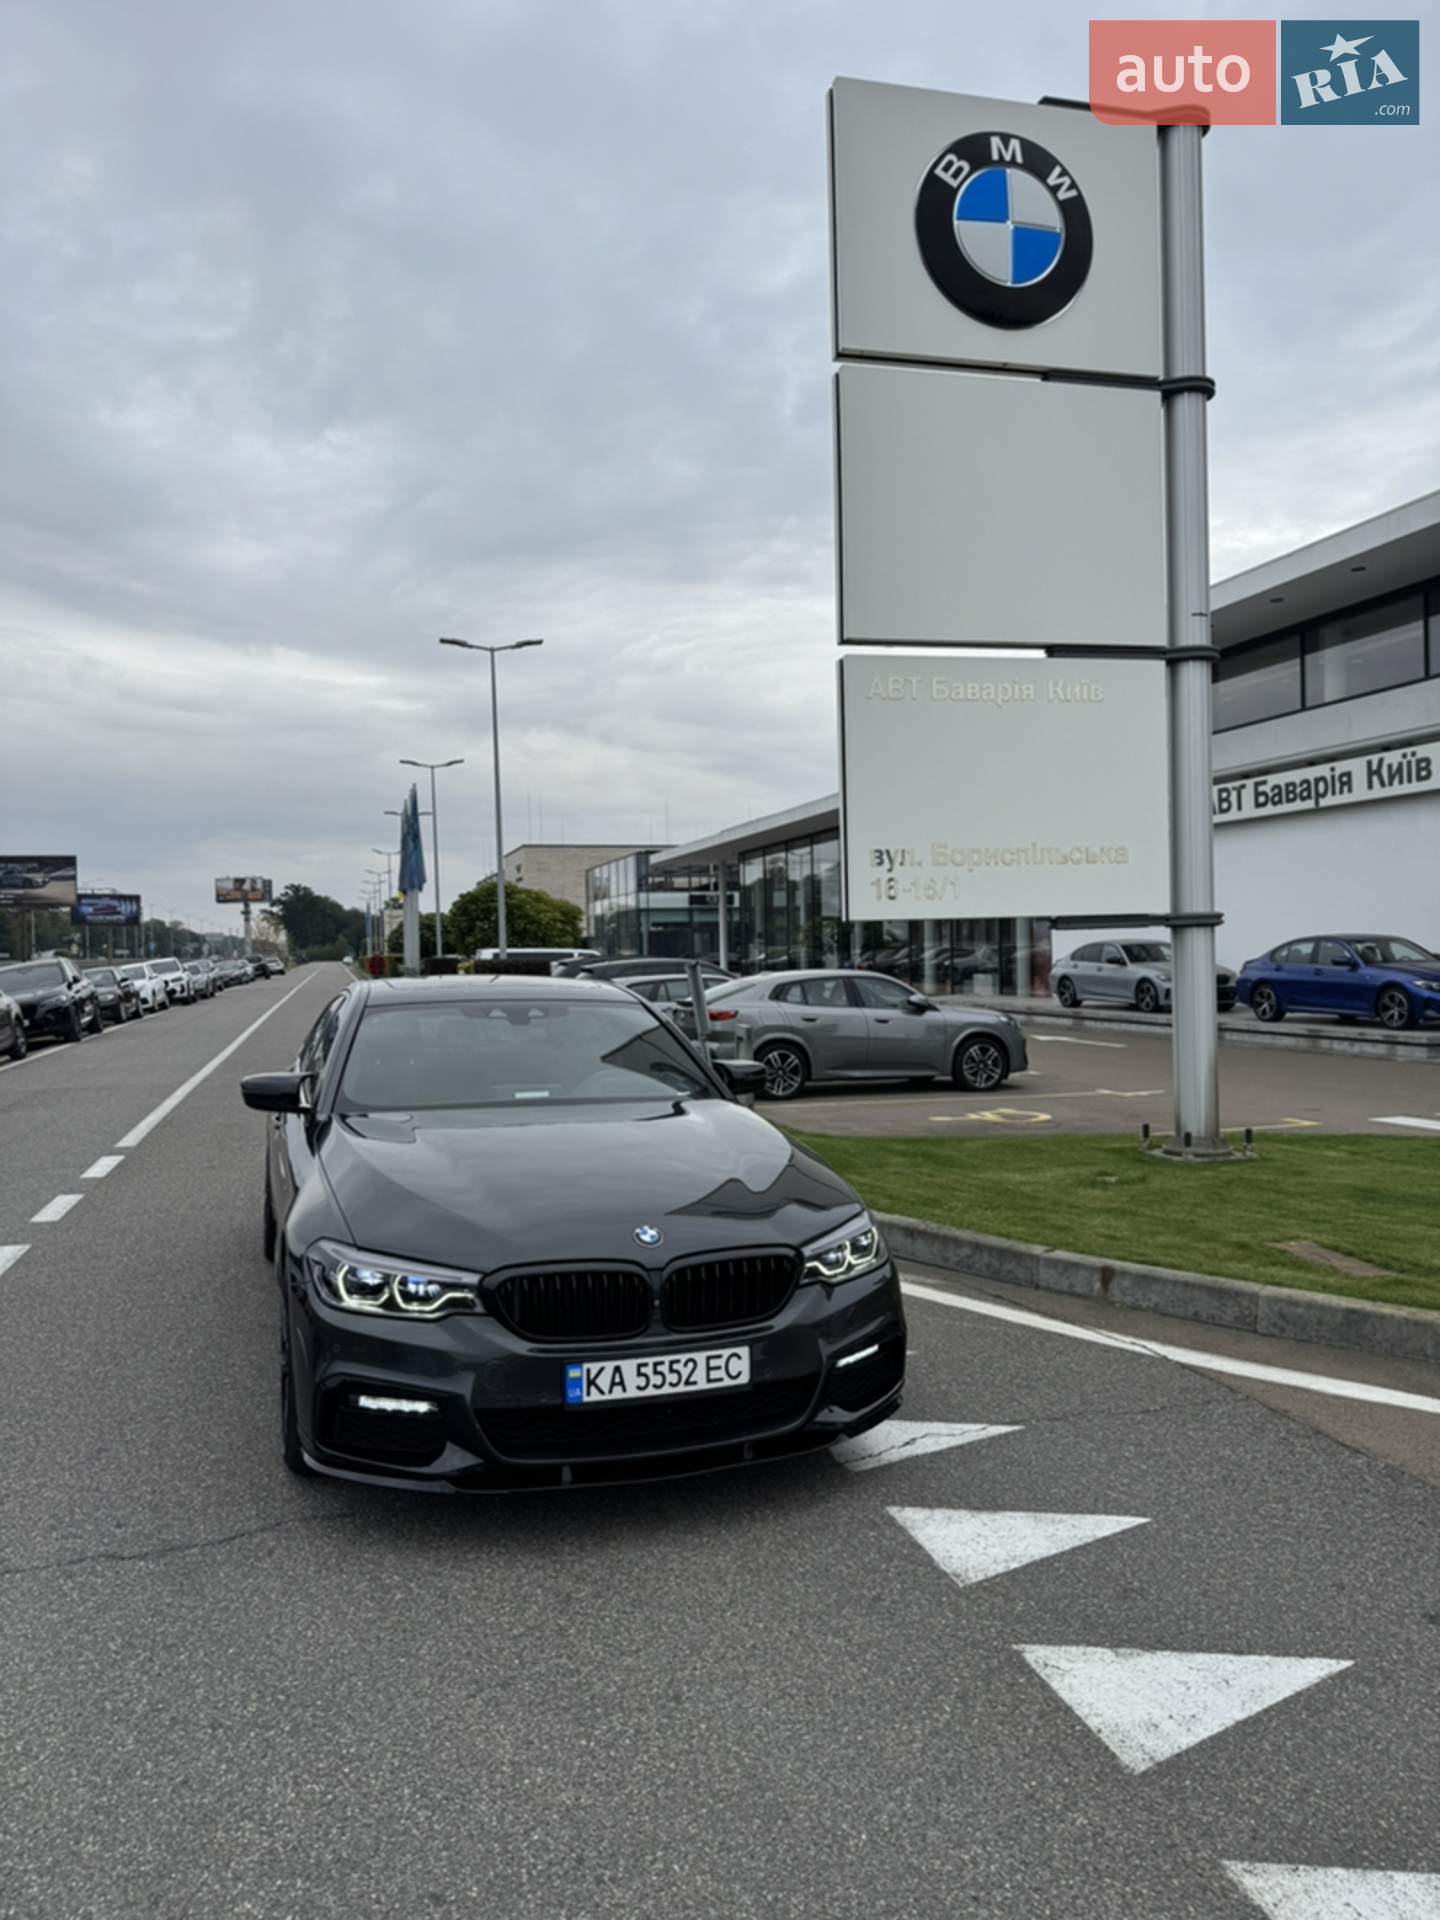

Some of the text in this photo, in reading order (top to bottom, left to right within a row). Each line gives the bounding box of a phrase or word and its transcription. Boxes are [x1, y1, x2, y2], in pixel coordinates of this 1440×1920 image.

[933, 135, 1079, 201] BMW
[866, 675, 1104, 708] АВТ Баварія Київ
[1253, 766, 1354, 808] Баварія
[1366, 750, 1433, 791] Київ
[869, 842, 1129, 873] вул. Бориспільська
[585, 1352, 743, 1398] KA 5552 EC
